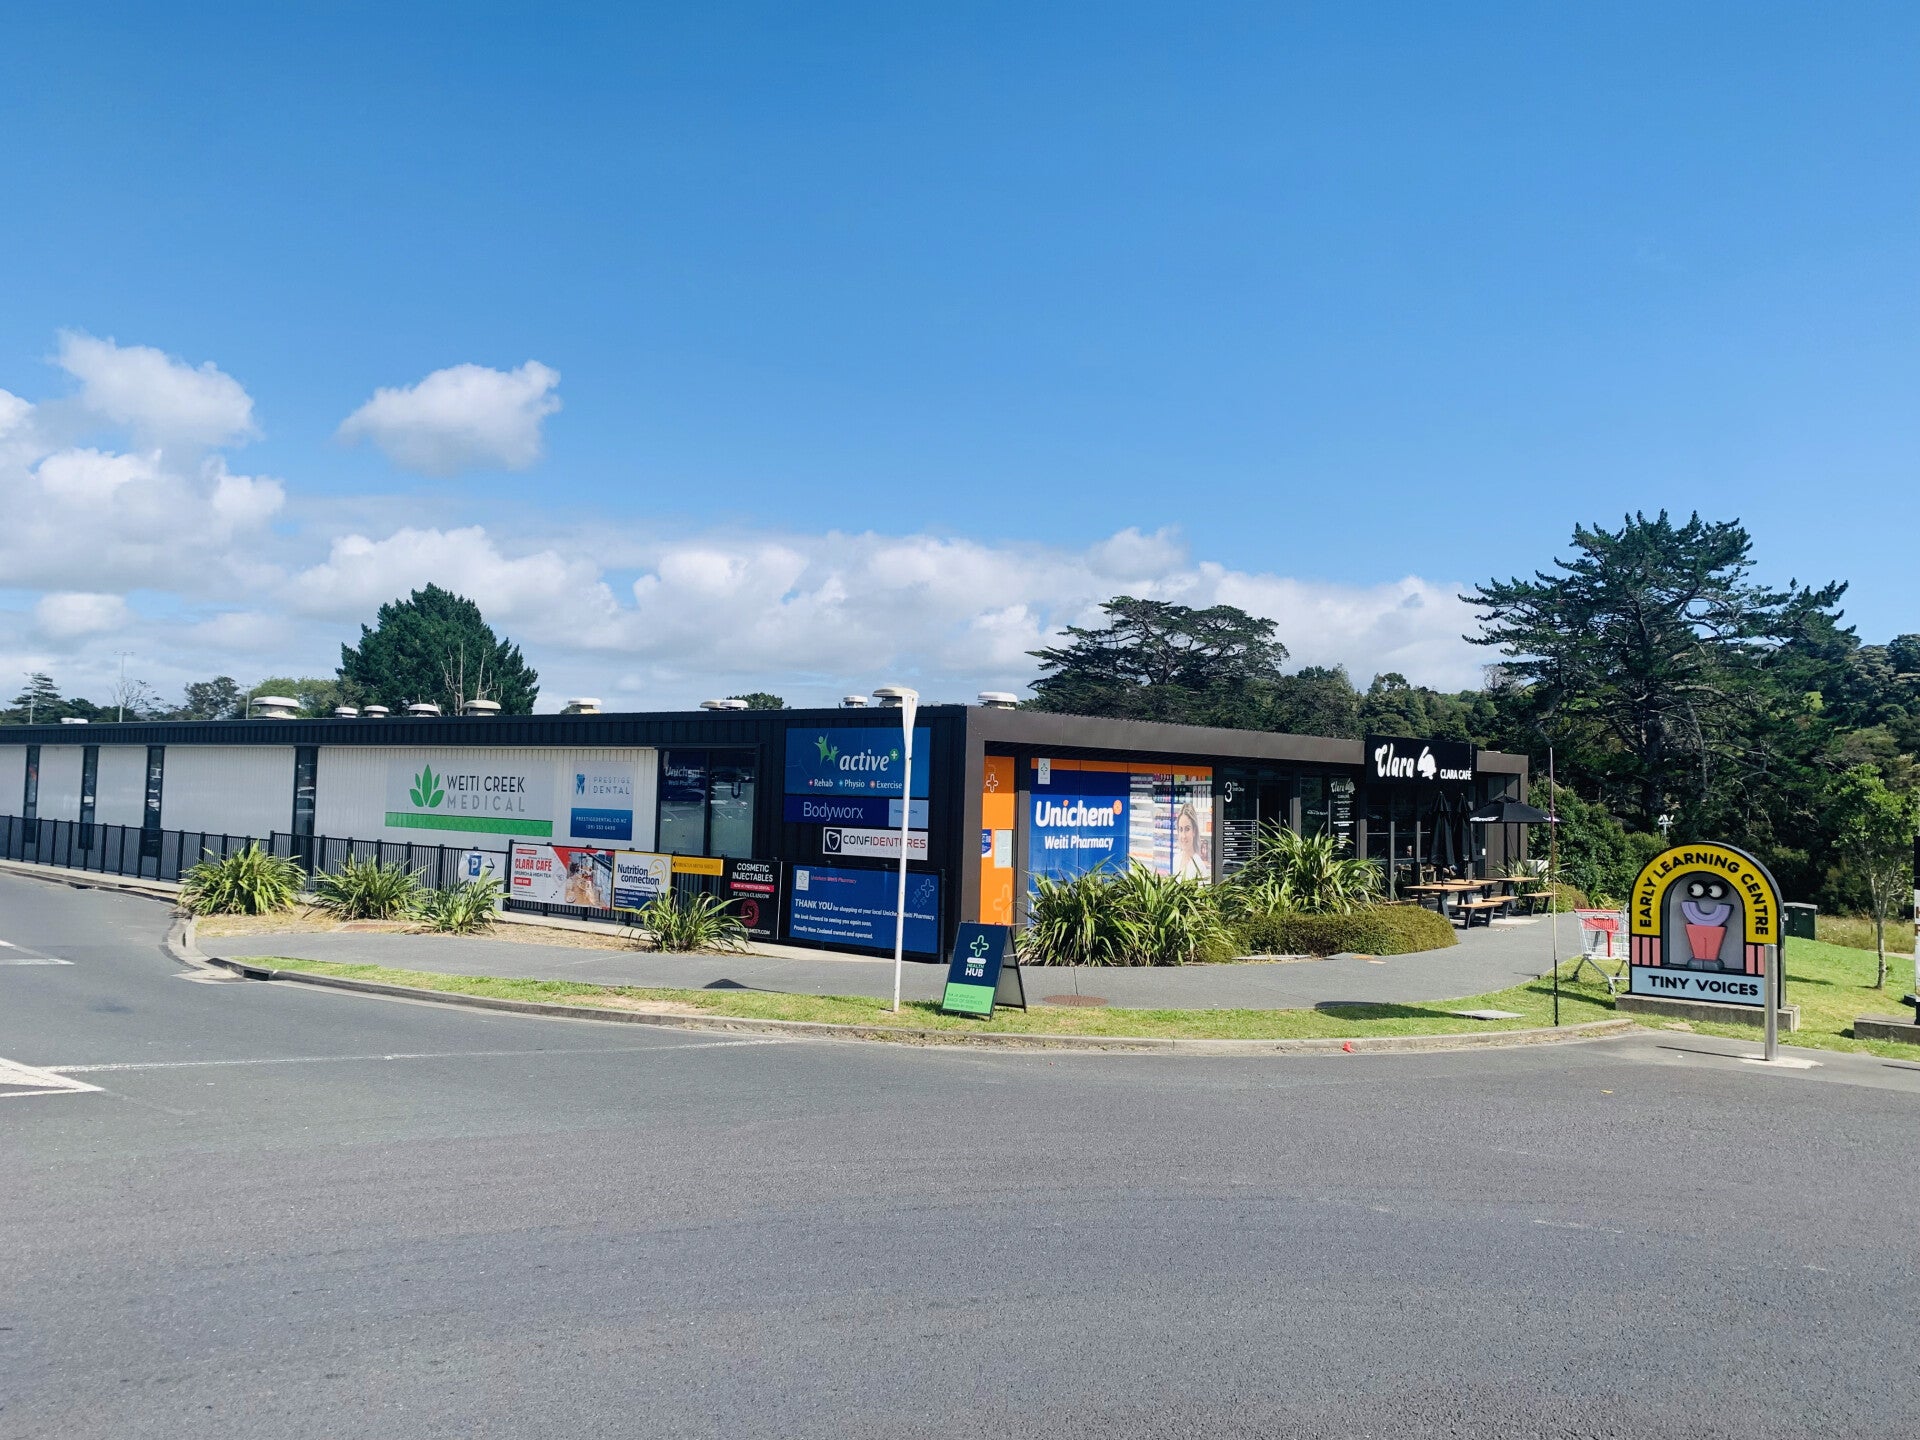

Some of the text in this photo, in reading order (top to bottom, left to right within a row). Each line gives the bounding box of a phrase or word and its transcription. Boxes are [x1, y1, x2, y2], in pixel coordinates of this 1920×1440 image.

[839, 749, 889, 771] active
[1375, 743, 1414, 778] Clara
[1440, 769, 1459, 780] CLARA
[447, 775, 525, 793] WEITI CREEK
[593, 786, 630, 794] DENTAL
[814, 779, 903, 789] Rehab Physio Exercise
[1225, 781, 1232, 803] 3
[447, 794, 525, 812] MEDICAL
[803, 801, 863, 821] Bodyworx
[1035, 800, 1114, 827] Unichem
[1044, 834, 1114, 852] Weiti Pharmacy
[515, 858, 552, 871] CLARA CAFE
[617, 864, 648, 876] Nutrition
[737, 863, 769, 872] COSMETIC
[621, 874, 660, 885] connection
[732, 872, 773, 882] INJECTABLES
[1640, 853, 1769, 935] EARLY LEARNING CENTRE
[795, 898, 817, 909] THANK
[818, 901, 833, 910] YOU
[840, 906, 857, 914] shopping
[794, 924, 807, 932] Proudly
[816, 927, 832, 935] Zealand
[965, 967, 984, 977] HUB
[1648, 975, 1758, 996] TINY VOICES
